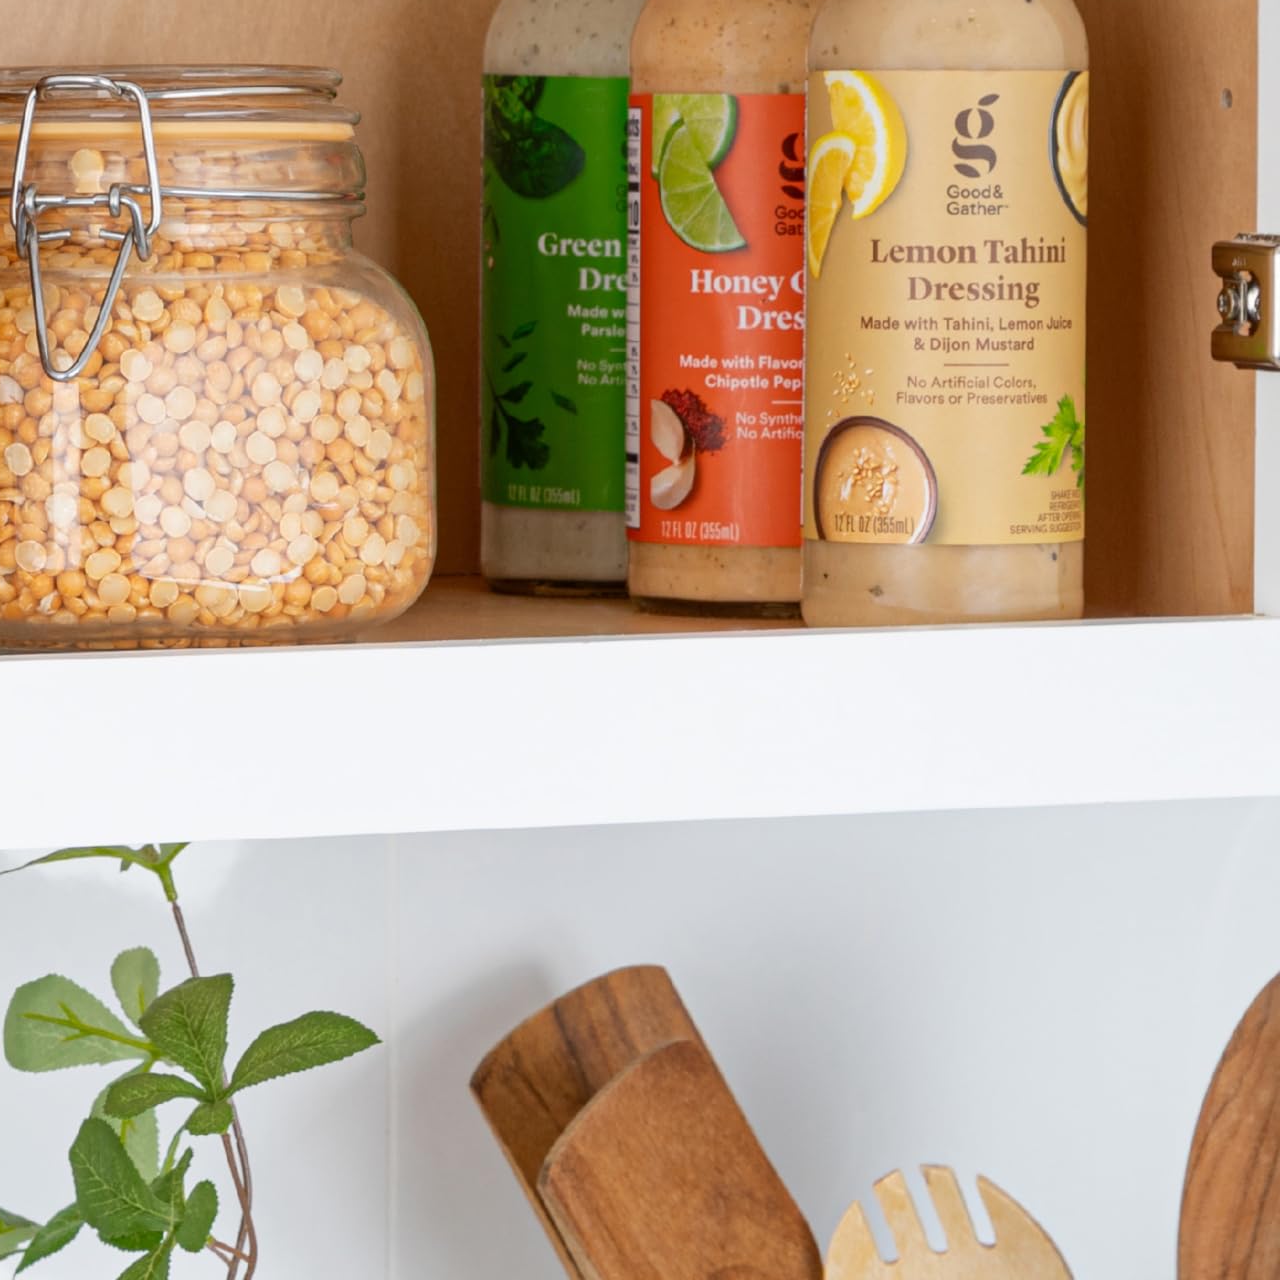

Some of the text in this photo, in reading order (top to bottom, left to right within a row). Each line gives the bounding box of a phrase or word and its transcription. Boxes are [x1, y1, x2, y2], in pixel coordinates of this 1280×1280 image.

[946, 184, 1004, 200] Good&
[537, 231, 623, 257] Green
[870, 236, 1067, 265] Lemon Tahini
[689, 268, 785, 301] Honey
[907, 274, 1041, 310] Dressing
[567, 303, 609, 318] Made
[860, 315, 1073, 333] Made with Tahini, Lemon Juice
[913, 337, 1035, 354] & Dijon Mustard
[576, 359, 597, 371] No
[679, 353, 718, 369] Made
[721, 354, 755, 370] with
[577, 373, 598, 385] No
[704, 373, 769, 390] Chipotle
[907, 375, 1037, 390] No Artificial Colors,
[896, 391, 1048, 405] Flavors or Preservatives
[735, 412, 756, 425] No
[736, 427, 758, 440] No
[661, 520, 740, 542] 12 FL OZ (355mL)
[834, 514, 915, 536] 12 FL OZ (355mL)
